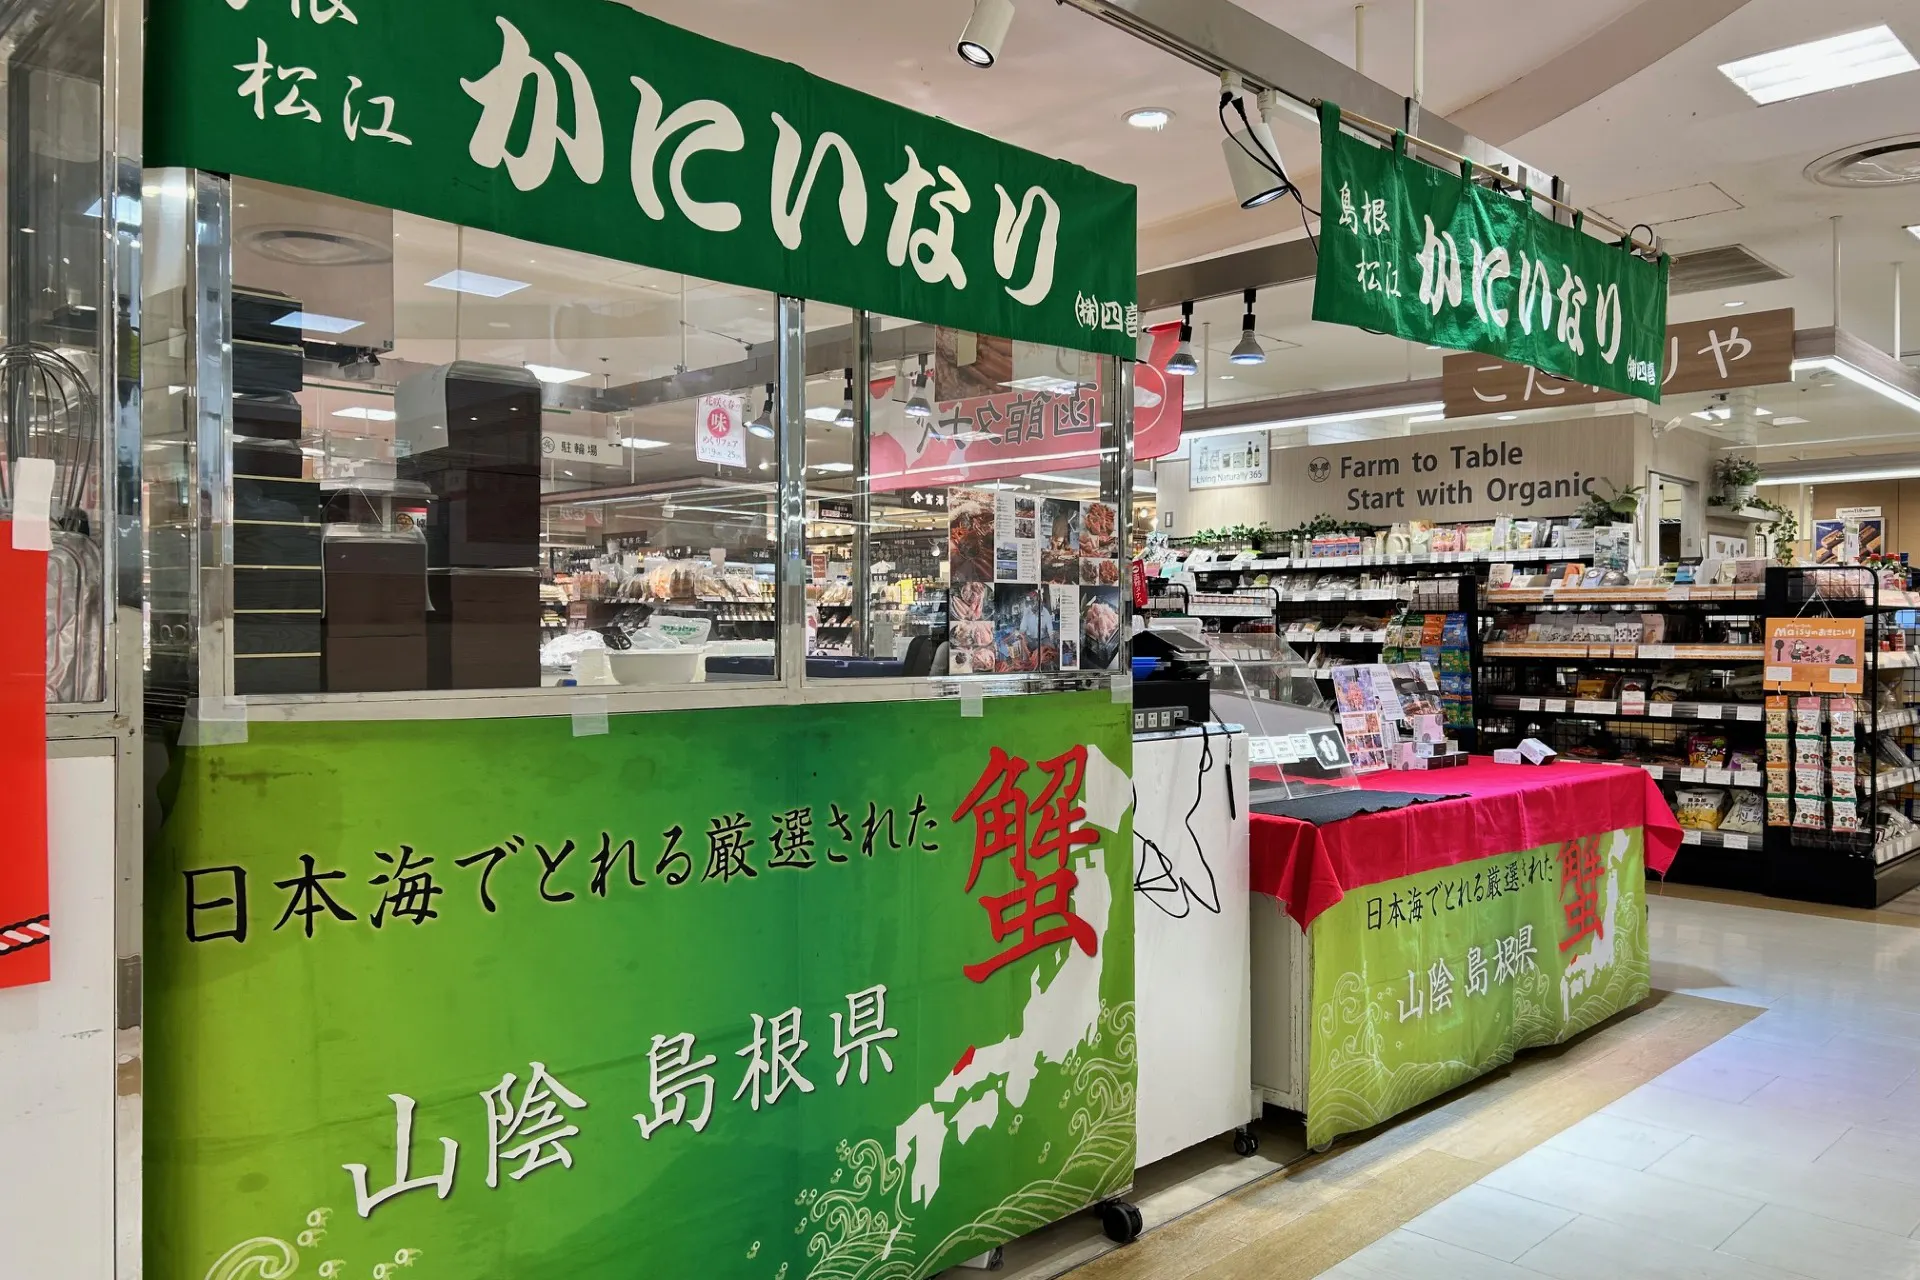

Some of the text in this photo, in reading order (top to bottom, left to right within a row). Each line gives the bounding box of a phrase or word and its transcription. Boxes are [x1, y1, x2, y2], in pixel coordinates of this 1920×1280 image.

[232, 37, 413, 146] 松江
[459, 15, 1061, 306] かにいなり
[1339, 181, 1391, 236] 島根
[1355, 248, 1402, 299] 松江
[1416, 214, 1622, 364] かにいなり
[561, 441, 598, 457] 駐輪場
[711, 412, 727, 432] 味
[1340, 441, 1523, 479] Farm to Table
[1249, 469, 1263, 479] 365
[1347, 471, 1596, 511] Start with Organic
[182, 793, 940, 944] 日本海でとれる厳選された
[951, 743, 1100, 984] 蟹
[1366, 851, 1554, 931] 日本海でとれる厳選された
[1555, 838, 1606, 954] 蟹
[1396, 924, 1538, 1024] 山陰 島根県
[342, 983, 899, 1219] 山陰 島根県
